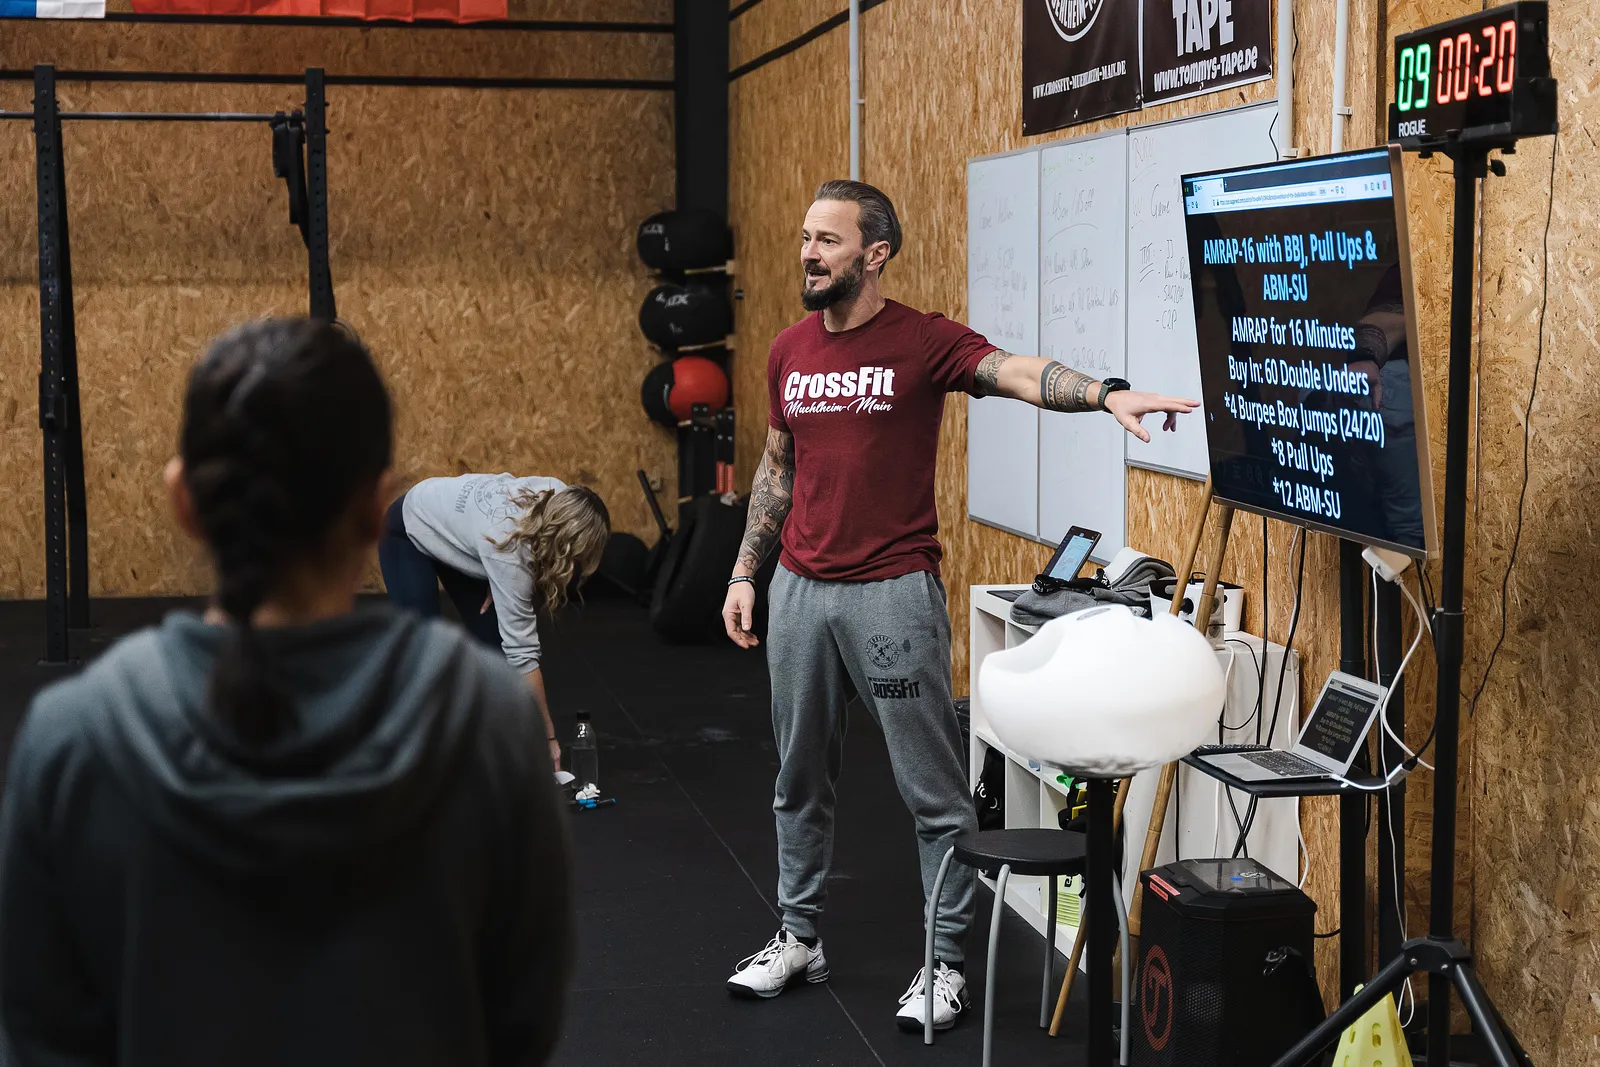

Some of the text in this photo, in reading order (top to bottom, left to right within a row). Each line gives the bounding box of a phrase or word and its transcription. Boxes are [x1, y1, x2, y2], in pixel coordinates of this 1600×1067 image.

[1172, 0, 1234, 57] TAPE
[1398, 19, 1517, 112] 09 00:20
[1398, 118, 1427, 138] ROGUE
[1203, 229, 1378, 269] AMRAP-16 with BBJ, Pull Ups &
[1263, 273, 1308, 302] ABM-SU
[1232, 316, 1356, 350] AMRAP for 16 Minutes
[784, 366, 895, 401] CrossFit
[1228, 355, 1370, 396] Buy In: 60 Double Unders
[1238, 398, 1276, 430] Burpee
[1277, 400, 1299, 429] Box
[1299, 403, 1338, 441] Jumps
[1339, 408, 1385, 448] (24/20)
[1287, 441, 1309, 471] Pull
[1310, 445, 1334, 482] Ups
[1295, 483, 1341, 519] ABM-SU
